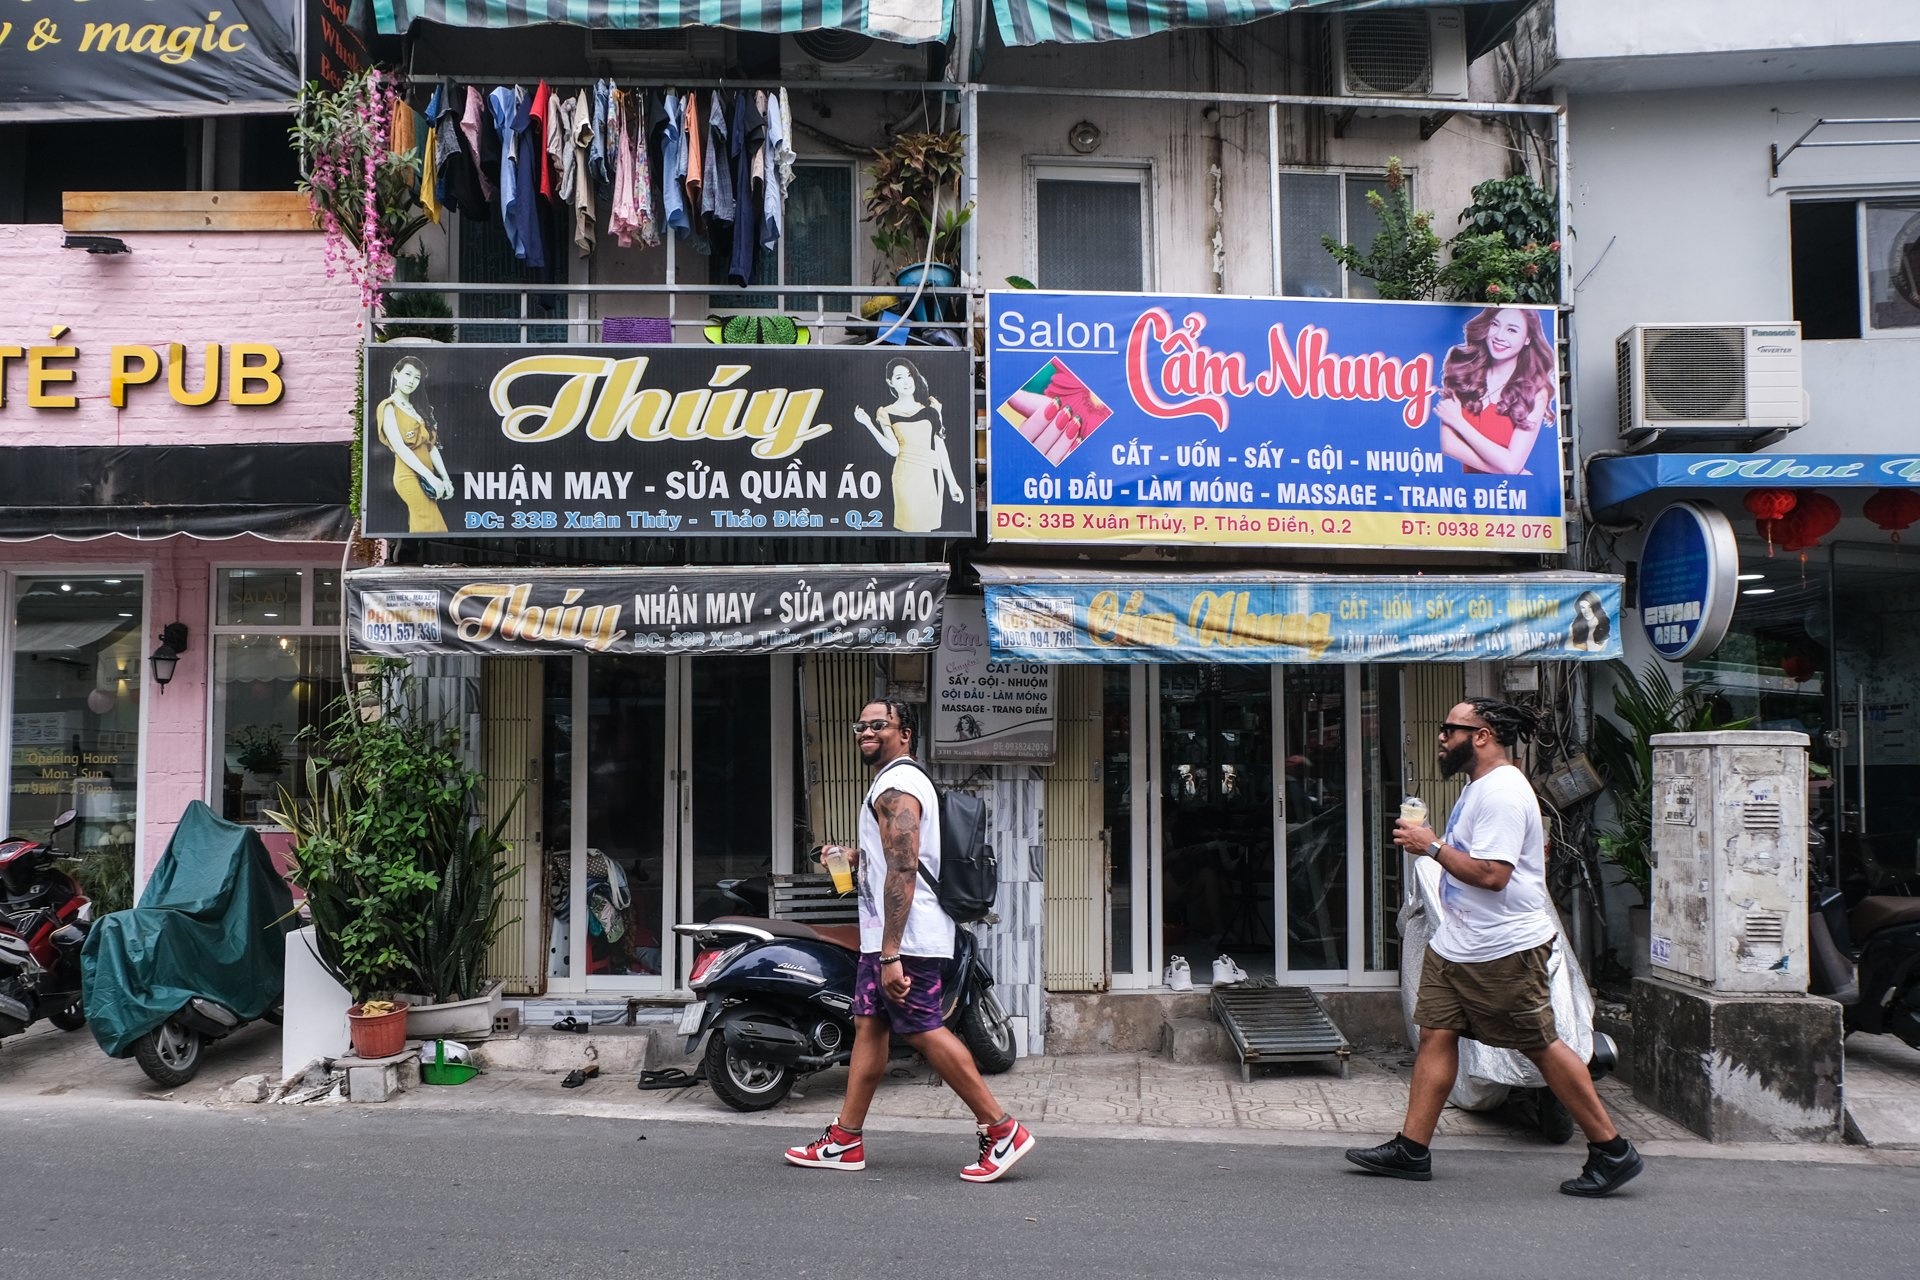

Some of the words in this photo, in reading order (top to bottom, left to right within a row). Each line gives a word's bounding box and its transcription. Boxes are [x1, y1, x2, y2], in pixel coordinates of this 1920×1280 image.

[27, 17, 61, 52] &
[78, 11, 248, 65] magic
[997, 311, 1116, 349] Salon
[1752, 328, 1796, 337] Panasonic
[109, 343, 284, 409] PUB
[1126, 306, 1254, 432] Cẩm
[1256, 322, 1438, 429] Nhung
[489, 354, 833, 460] Thúy
[1111, 437, 1153, 466] CẮT
[1177, 439, 1221, 468] UỐN
[1244, 440, 1285, 469] SẤY
[1307, 445, 1343, 475] GỘI
[1366, 447, 1444, 477] NHUỘM
[463, 464, 552, 506] NHẬN
[564, 471, 634, 500] MAY
[666, 460, 730, 499] SỬA
[740, 459, 827, 504] QUẦN
[837, 464, 882, 499] ÁO
[1024, 474, 1061, 504] GỘI
[1068, 471, 1113, 500] ĐẦU
[1137, 475, 1182, 502] LÀM
[1190, 476, 1254, 503] MÓNG
[1277, 483, 1377, 506] MASSAGE
[1399, 486, 1467, 509] TRANG
[1474, 480, 1527, 510] ĐIỂM
[465, 510, 505, 529] ĐC:
[511, 510, 558, 529] 33B
[564, 510, 621, 529] Xuân
[627, 509, 683, 531] Thủy
[711, 509, 767, 528] Thảo
[773, 508, 824, 528] Điền
[845, 510, 883, 529] Q.2
[997, 512, 1032, 528] ĐC:
[1039, 513, 1075, 529] 33B
[1082, 513, 1130, 530] Xuân
[1136, 513, 1187, 533] Thủy,
[1193, 516, 1208, 531] P.
[1215, 515, 1262, 532] Thảo
[1267, 517, 1315, 535] Điền,
[1321, 518, 1352, 535] Q.2
[1401, 520, 1431, 536] ĐT:
[1437, 520, 1479, 538] 0938
[1485, 522, 1516, 538] 242
[1521, 523, 1553, 539] 076
[634, 584, 698, 632] NHẬN
[706, 592, 757, 624] MAY
[779, 579, 825, 624] SỬA
[833, 577, 895, 627] QUẦN
[901, 582, 933, 622] ÁO
[1339, 591, 1368, 620] CẮT
[1382, 593, 1413, 620] UỐN
[1425, 592, 1455, 620] SẤY
[1468, 594, 1494, 623] GỘI
[449, 583, 627, 652] Thúy
[366, 623, 438, 642] 0931.557.336
[669, 631, 706, 648] 33B
[709, 631, 754, 647] Xuân
[906, 626, 935, 645] Q.2
[1341, 629, 1365, 654] LÀM
[1408, 634, 1446, 652] TRANG
[948, 673, 969, 686] SẤY
[978, 675, 999, 689] GỘI
[1008, 676, 1048, 690] NHUỘM
[941, 688, 961, 701] GỘI
[993, 690, 1013, 700] LÀM
[1016, 690, 1048, 701] MÓNG
[941, 704, 985, 713] MASSAGE
[992, 705, 1023, 714] TRANG
[1025, 702, 1048, 715] ĐIỂM
[28, 752, 79, 767] Opening
[83, 752, 118, 764] Hours
[42, 768, 69, 779] Mon
[81, 768, 103, 779] Sun
